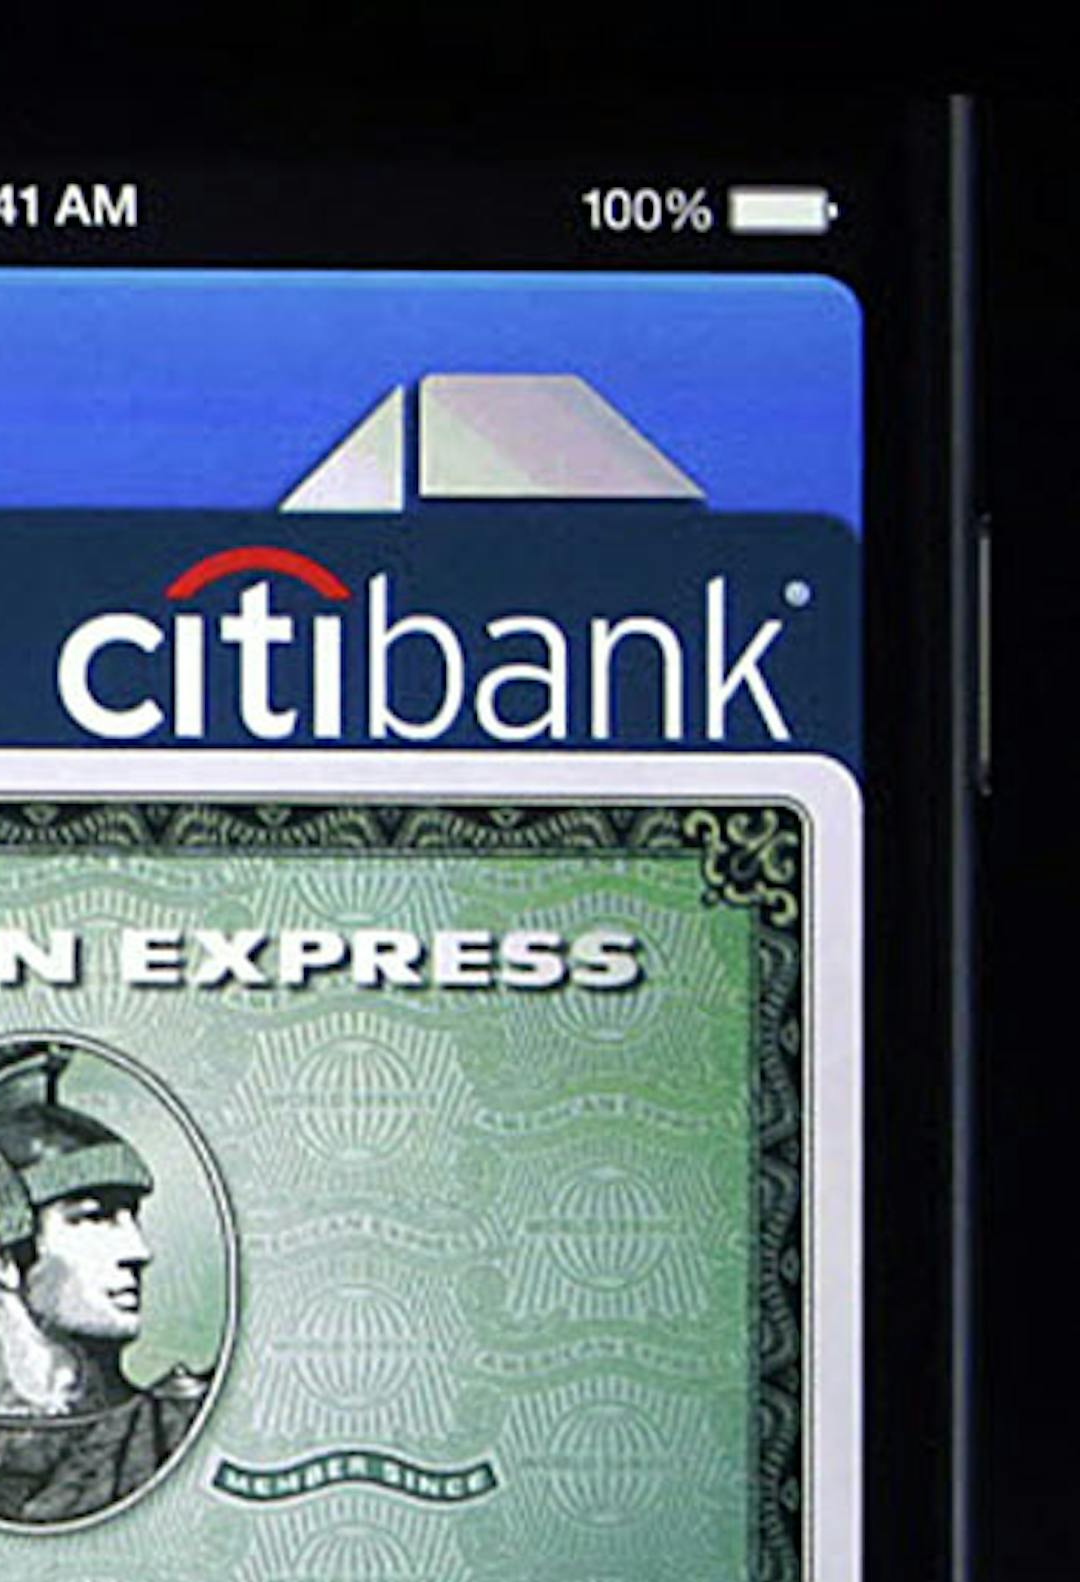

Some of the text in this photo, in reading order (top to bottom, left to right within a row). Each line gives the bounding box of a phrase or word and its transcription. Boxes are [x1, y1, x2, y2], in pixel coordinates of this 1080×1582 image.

[54, 183, 139, 228] AM
[582, 187, 713, 232] 100%
[57, 572, 792, 741] citibank
[123, 928, 644, 989] EXPRESS
